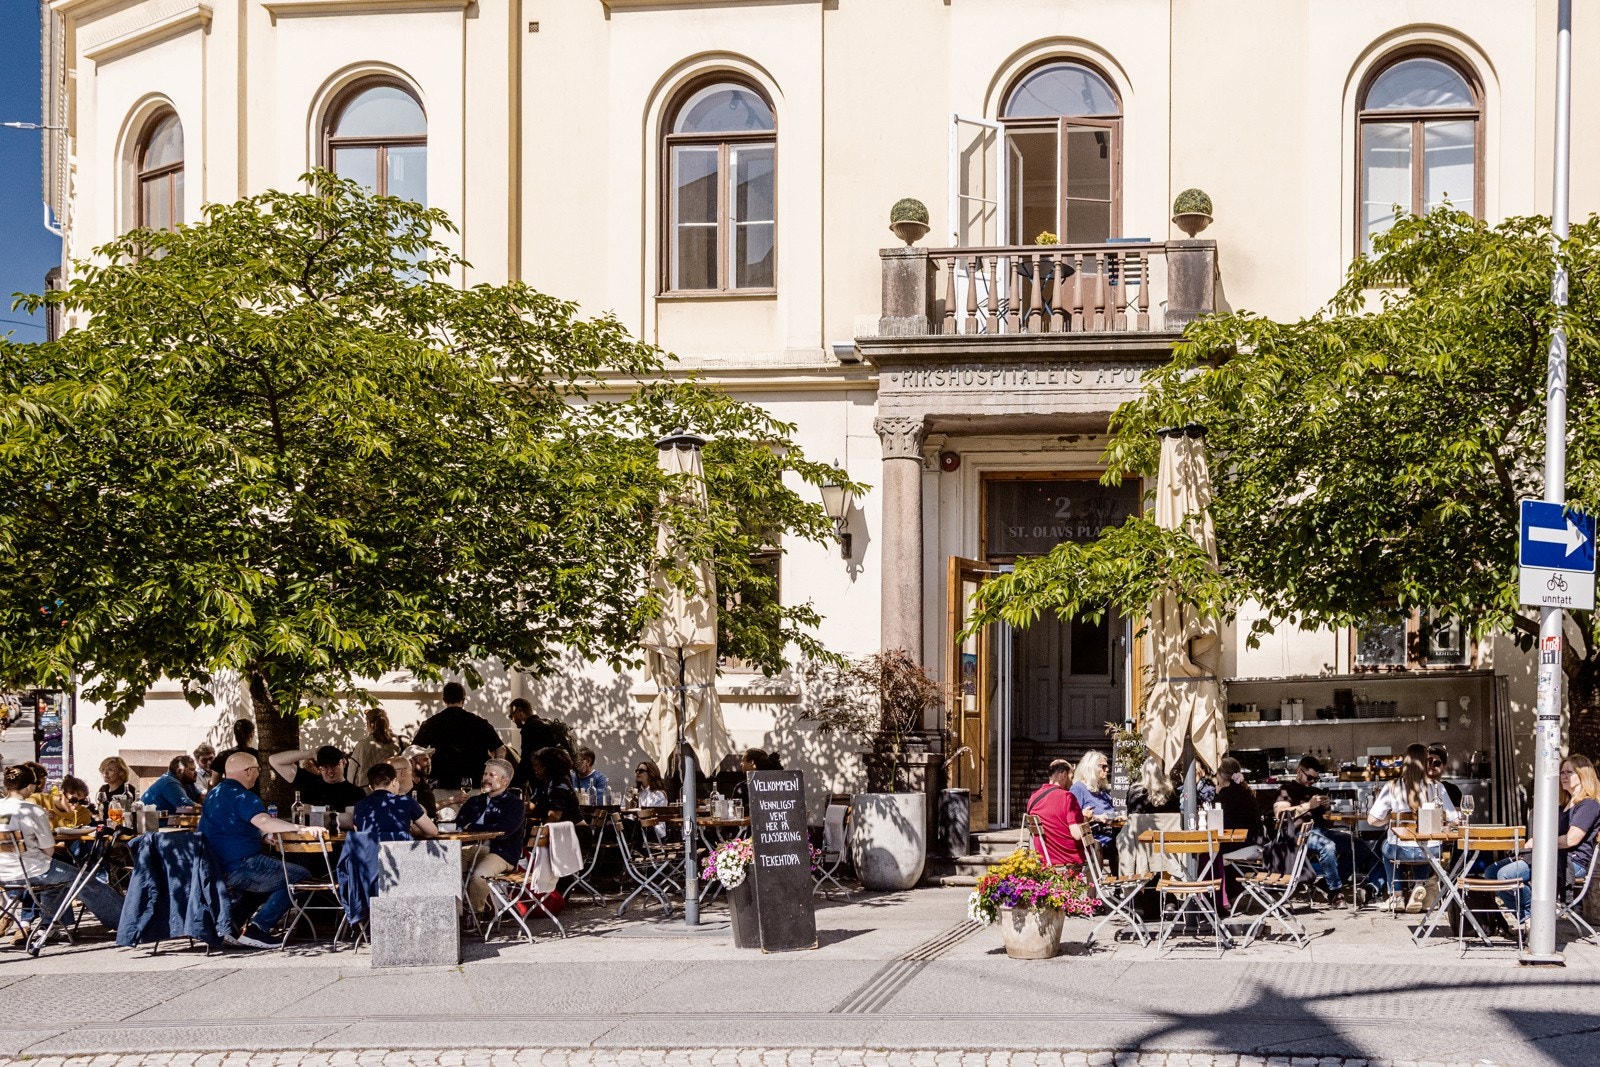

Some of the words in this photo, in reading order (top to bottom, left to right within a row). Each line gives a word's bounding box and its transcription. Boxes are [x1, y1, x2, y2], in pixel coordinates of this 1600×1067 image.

[1055, 496, 1071, 518] 2
[1008, 526, 1028, 538] ST.
[1032, 526, 1073, 538] OLAVS
[1078, 526, 1101, 538] PLA
[1542, 595, 1572, 605] unntatt
[43, 762, 74, 771] Burgr
[753, 777, 799, 791] VELKOMMEN!
[759, 799, 796, 810] VENNLIGST
[769, 811, 787, 821] VENT
[765, 822, 778, 831] HER
[760, 831, 801, 843] PLASSERING
[759, 853, 800, 867] TEKEHTOPA
